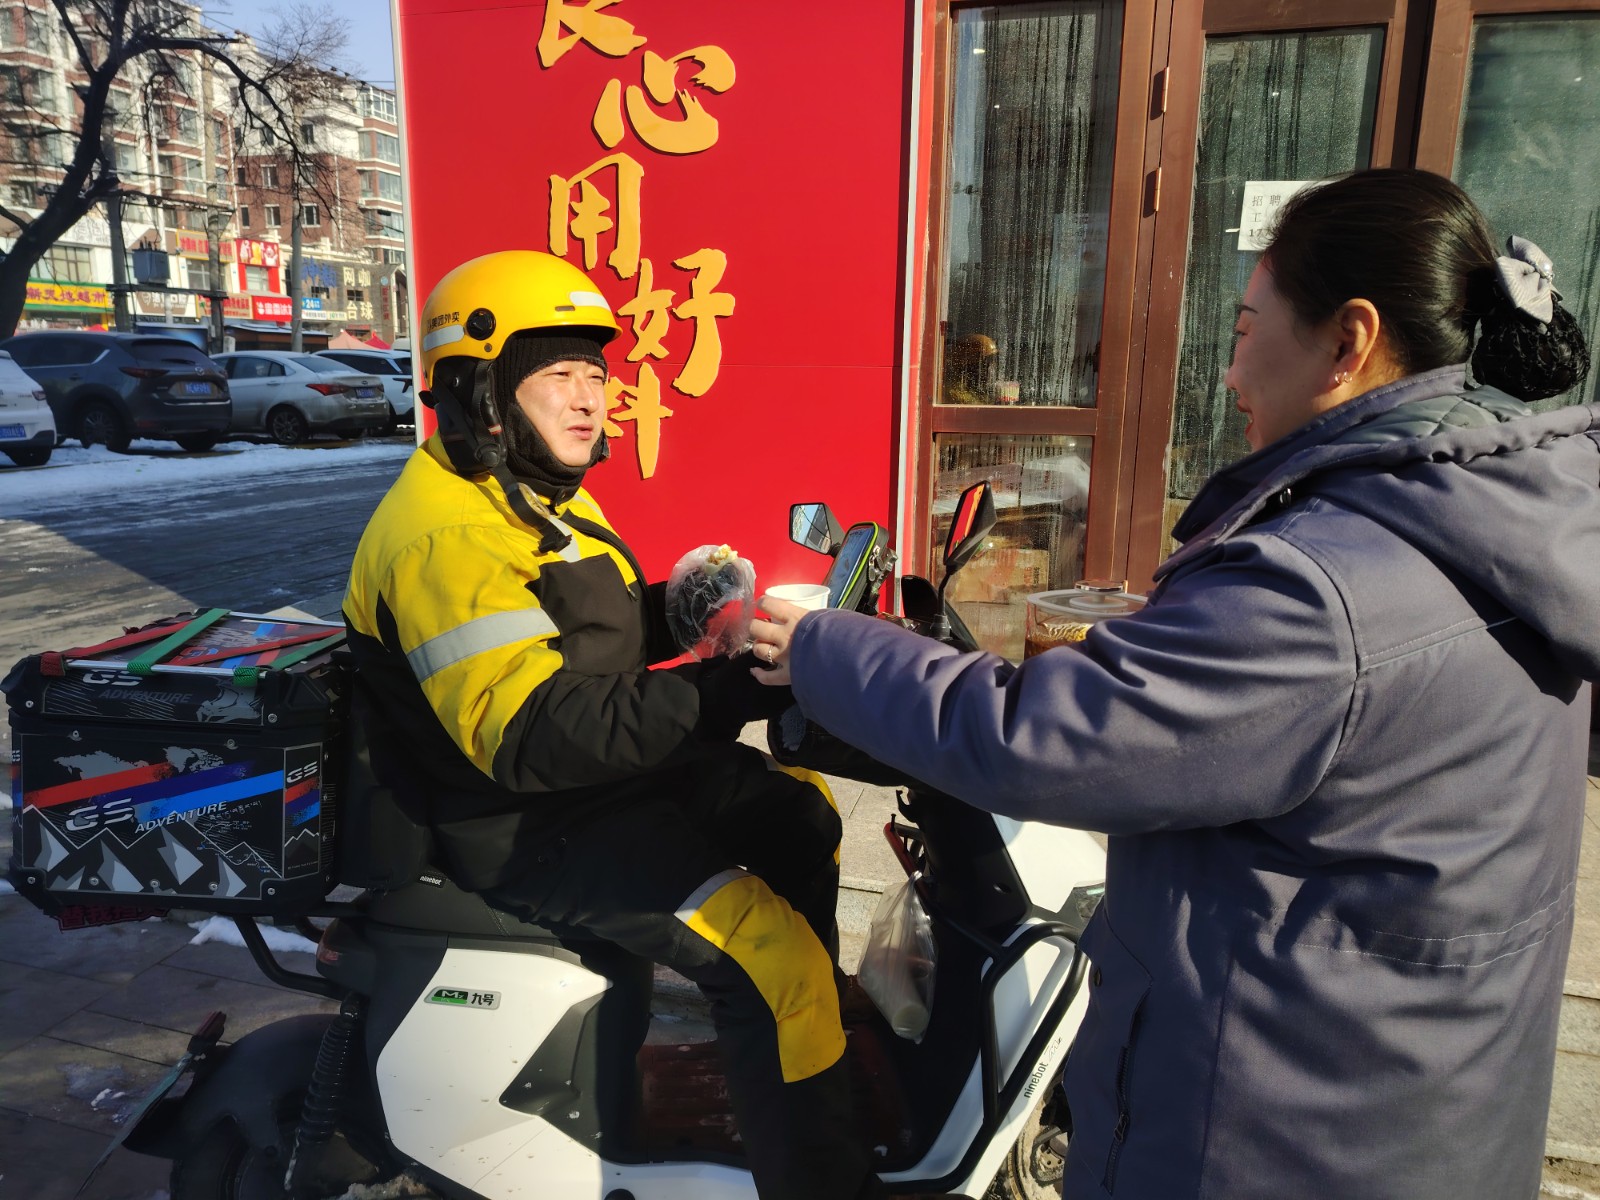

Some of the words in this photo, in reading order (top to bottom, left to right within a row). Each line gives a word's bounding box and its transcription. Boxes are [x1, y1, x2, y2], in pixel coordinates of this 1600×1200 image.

[343, 267, 371, 287] 网咖
[347, 301, 374, 320] 台球
[99, 689, 193, 703] ADVENTURE
[286, 760, 318, 783] GS
[65, 798, 135, 832] GS
[134, 800, 228, 834] ADVENTURE
[470, 993, 495, 1006] 九号
[1023, 1061, 1049, 1099] ninebot
